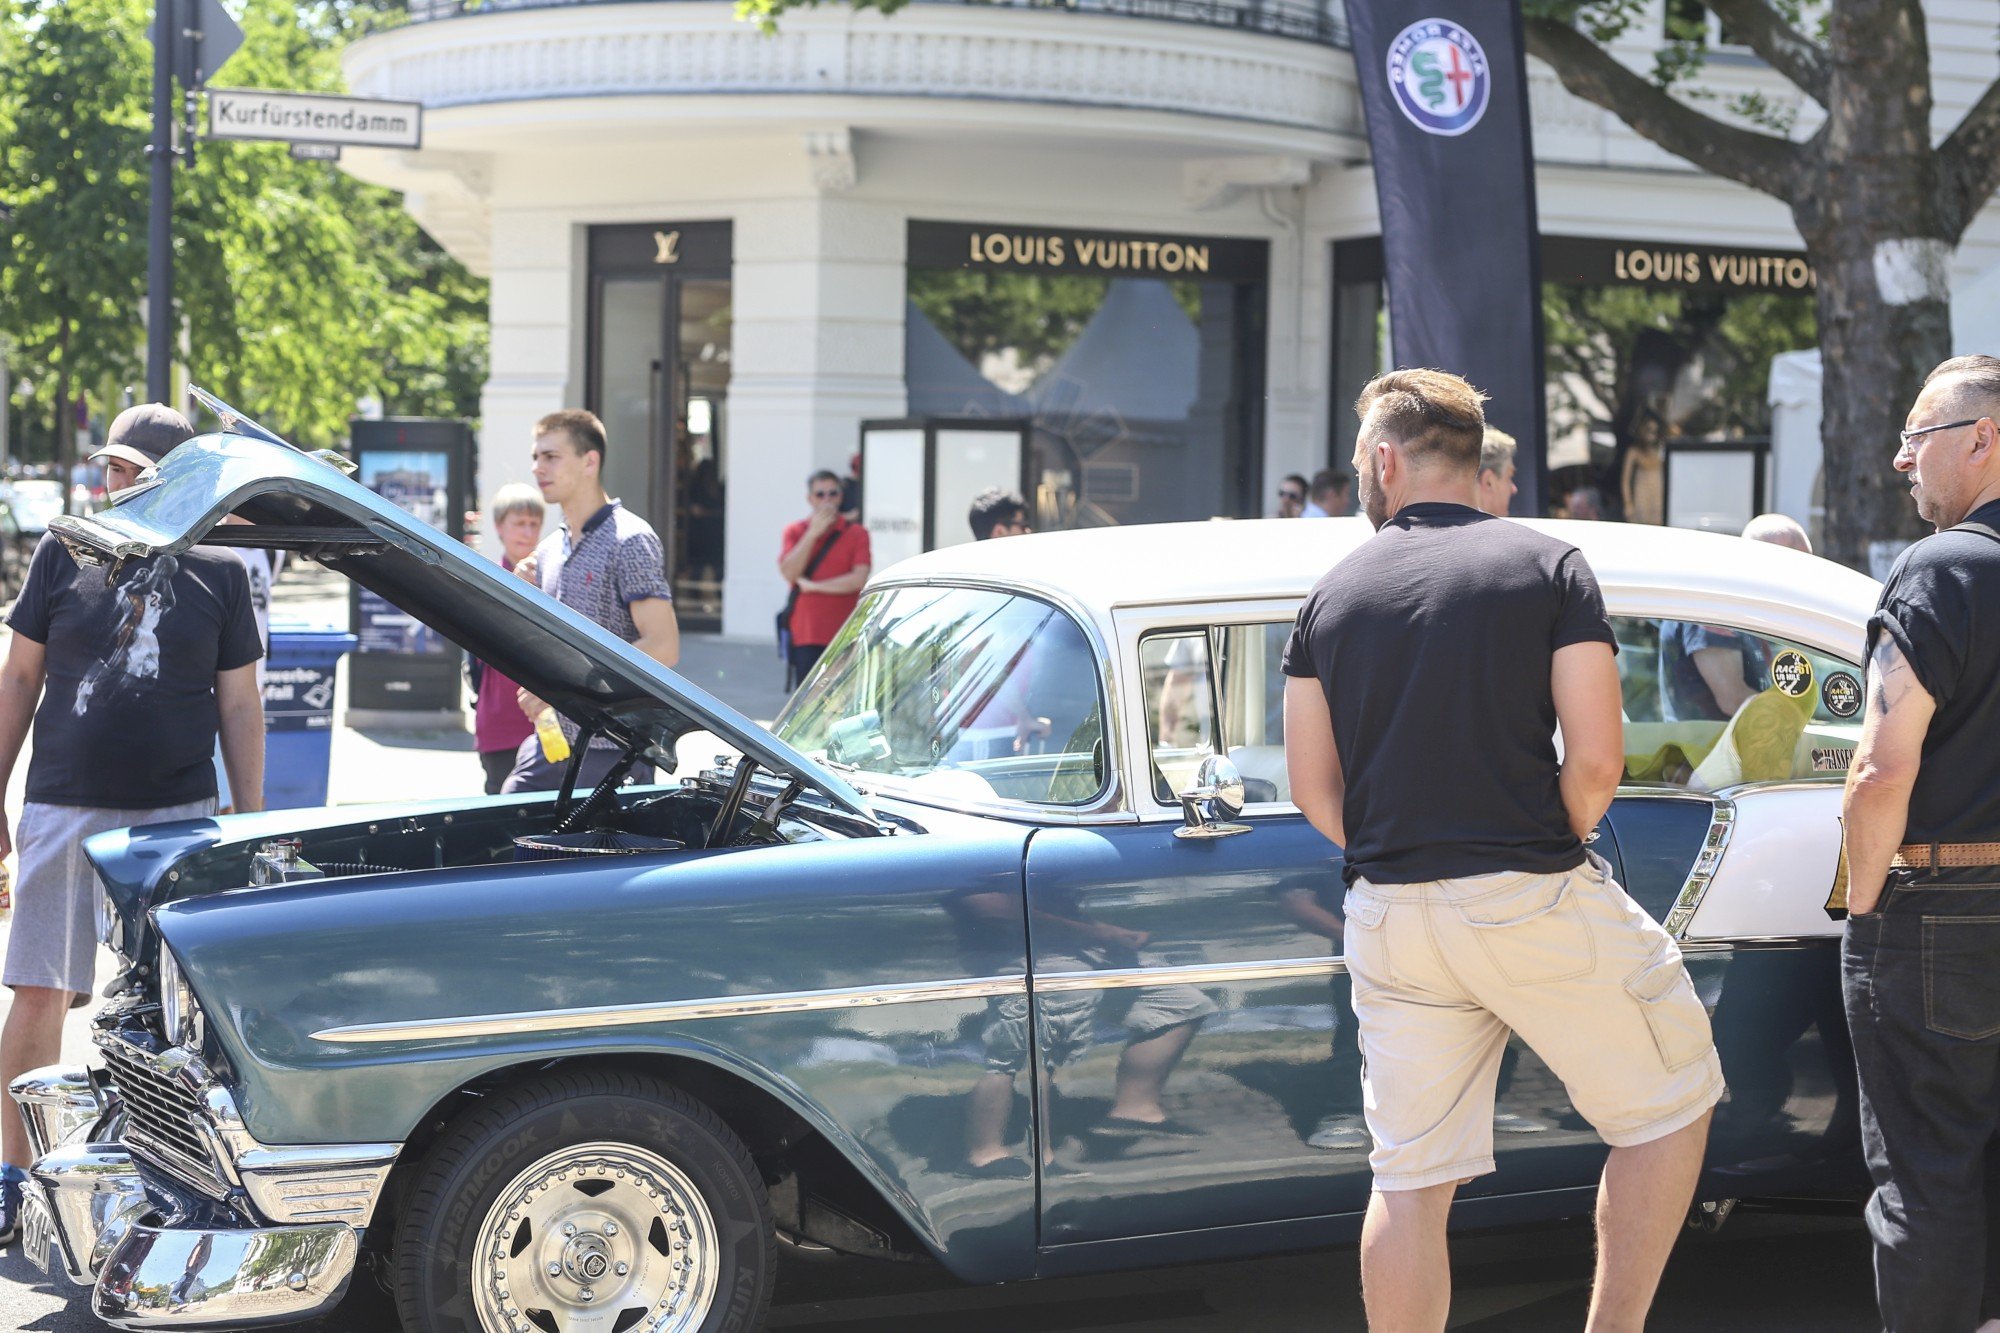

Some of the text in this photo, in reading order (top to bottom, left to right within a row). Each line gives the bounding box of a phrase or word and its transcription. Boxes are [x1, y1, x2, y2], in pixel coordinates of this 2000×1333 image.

[218, 101, 408, 133] Kurfürstendamm
[970, 233, 1209, 272] LOUIS VUITTON
[1615, 249, 1701, 283] LOUIS
[265, 685, 295, 700] fall
